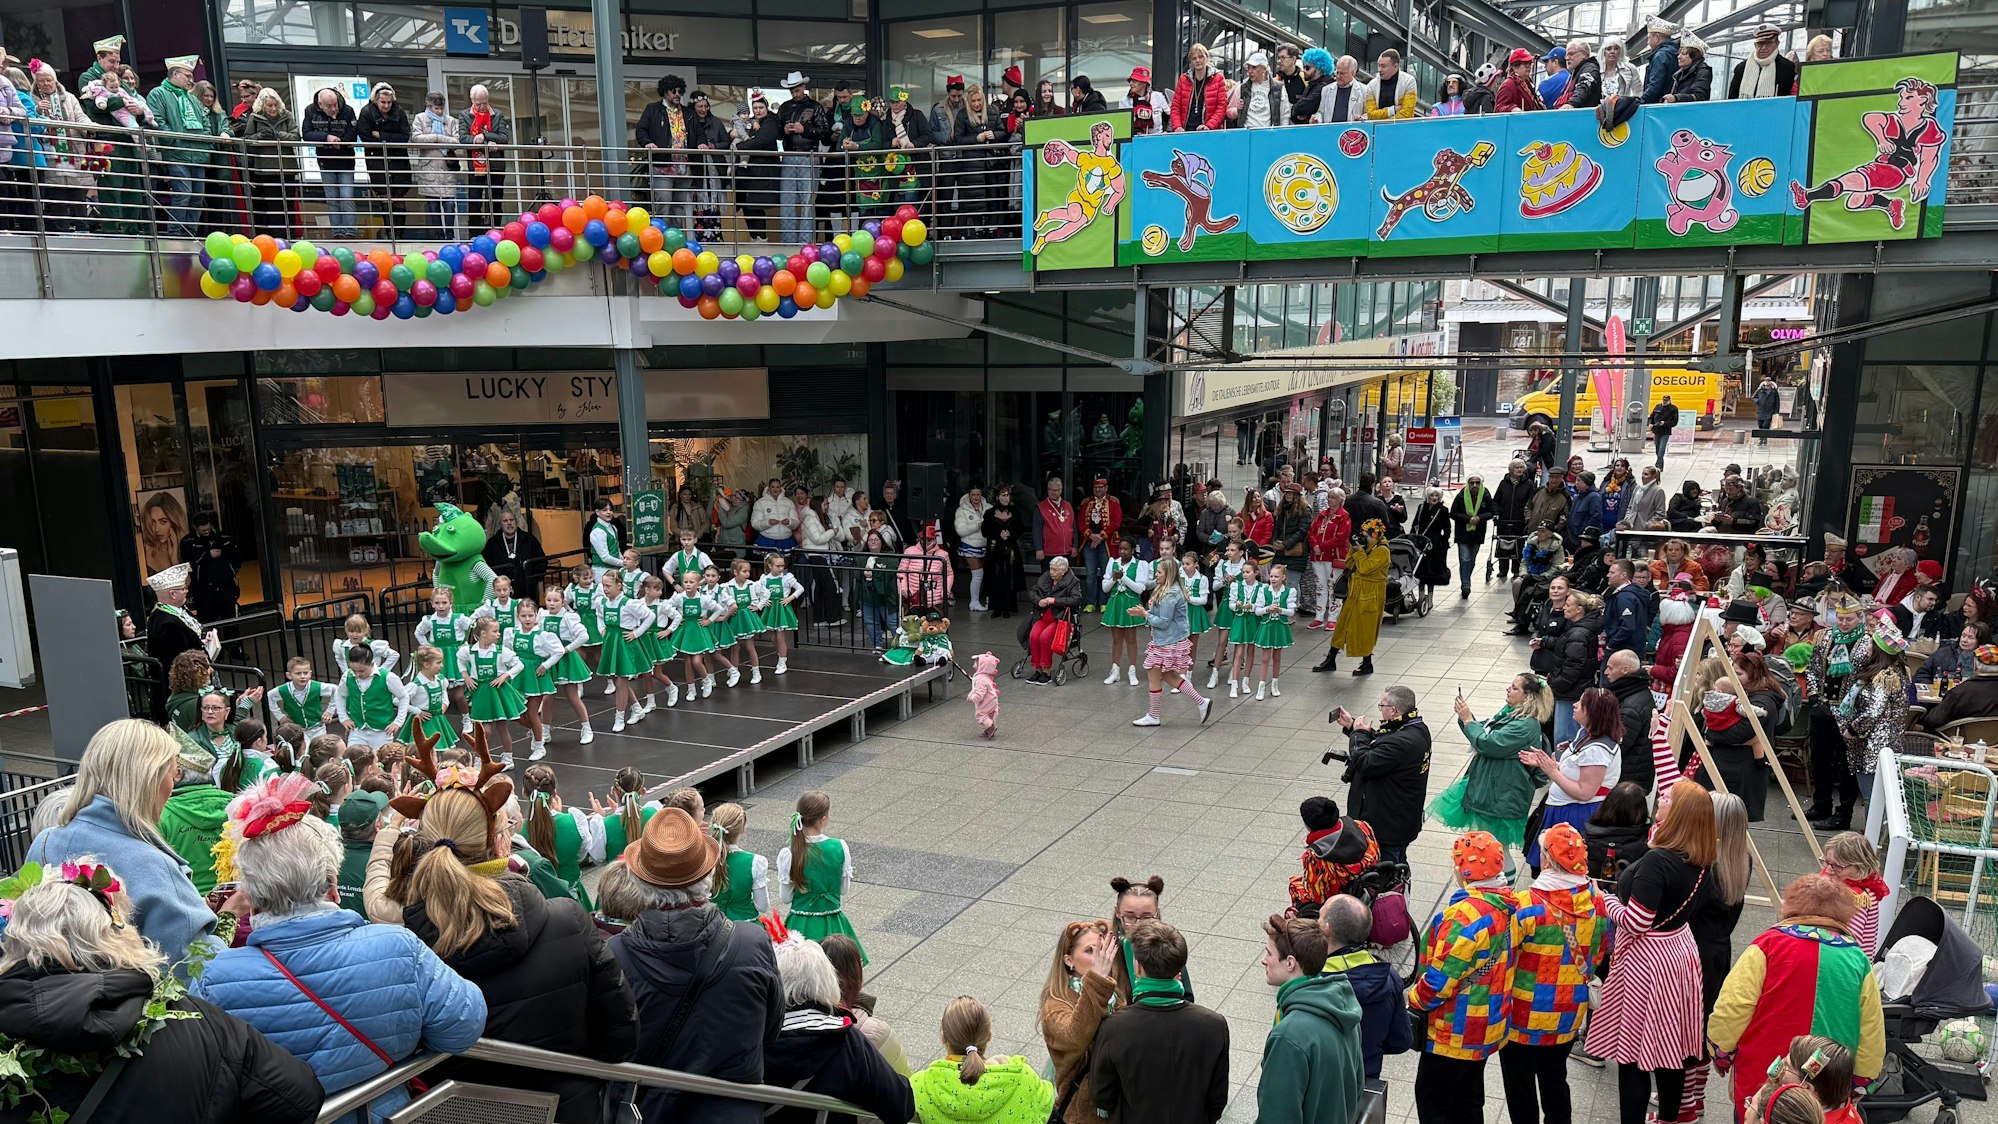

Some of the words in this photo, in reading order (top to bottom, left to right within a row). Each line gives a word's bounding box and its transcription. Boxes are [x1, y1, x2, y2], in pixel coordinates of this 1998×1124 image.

[452, 19, 482, 43] TK
[552, 22, 680, 51] Tecniker
[1771, 328, 1807, 340] OLYM
[465, 377, 546, 399] LUCKY
[570, 376, 613, 398] STY
[1653, 376, 1706, 386] OSEGUR
[220, 435, 248, 448] LUCK
